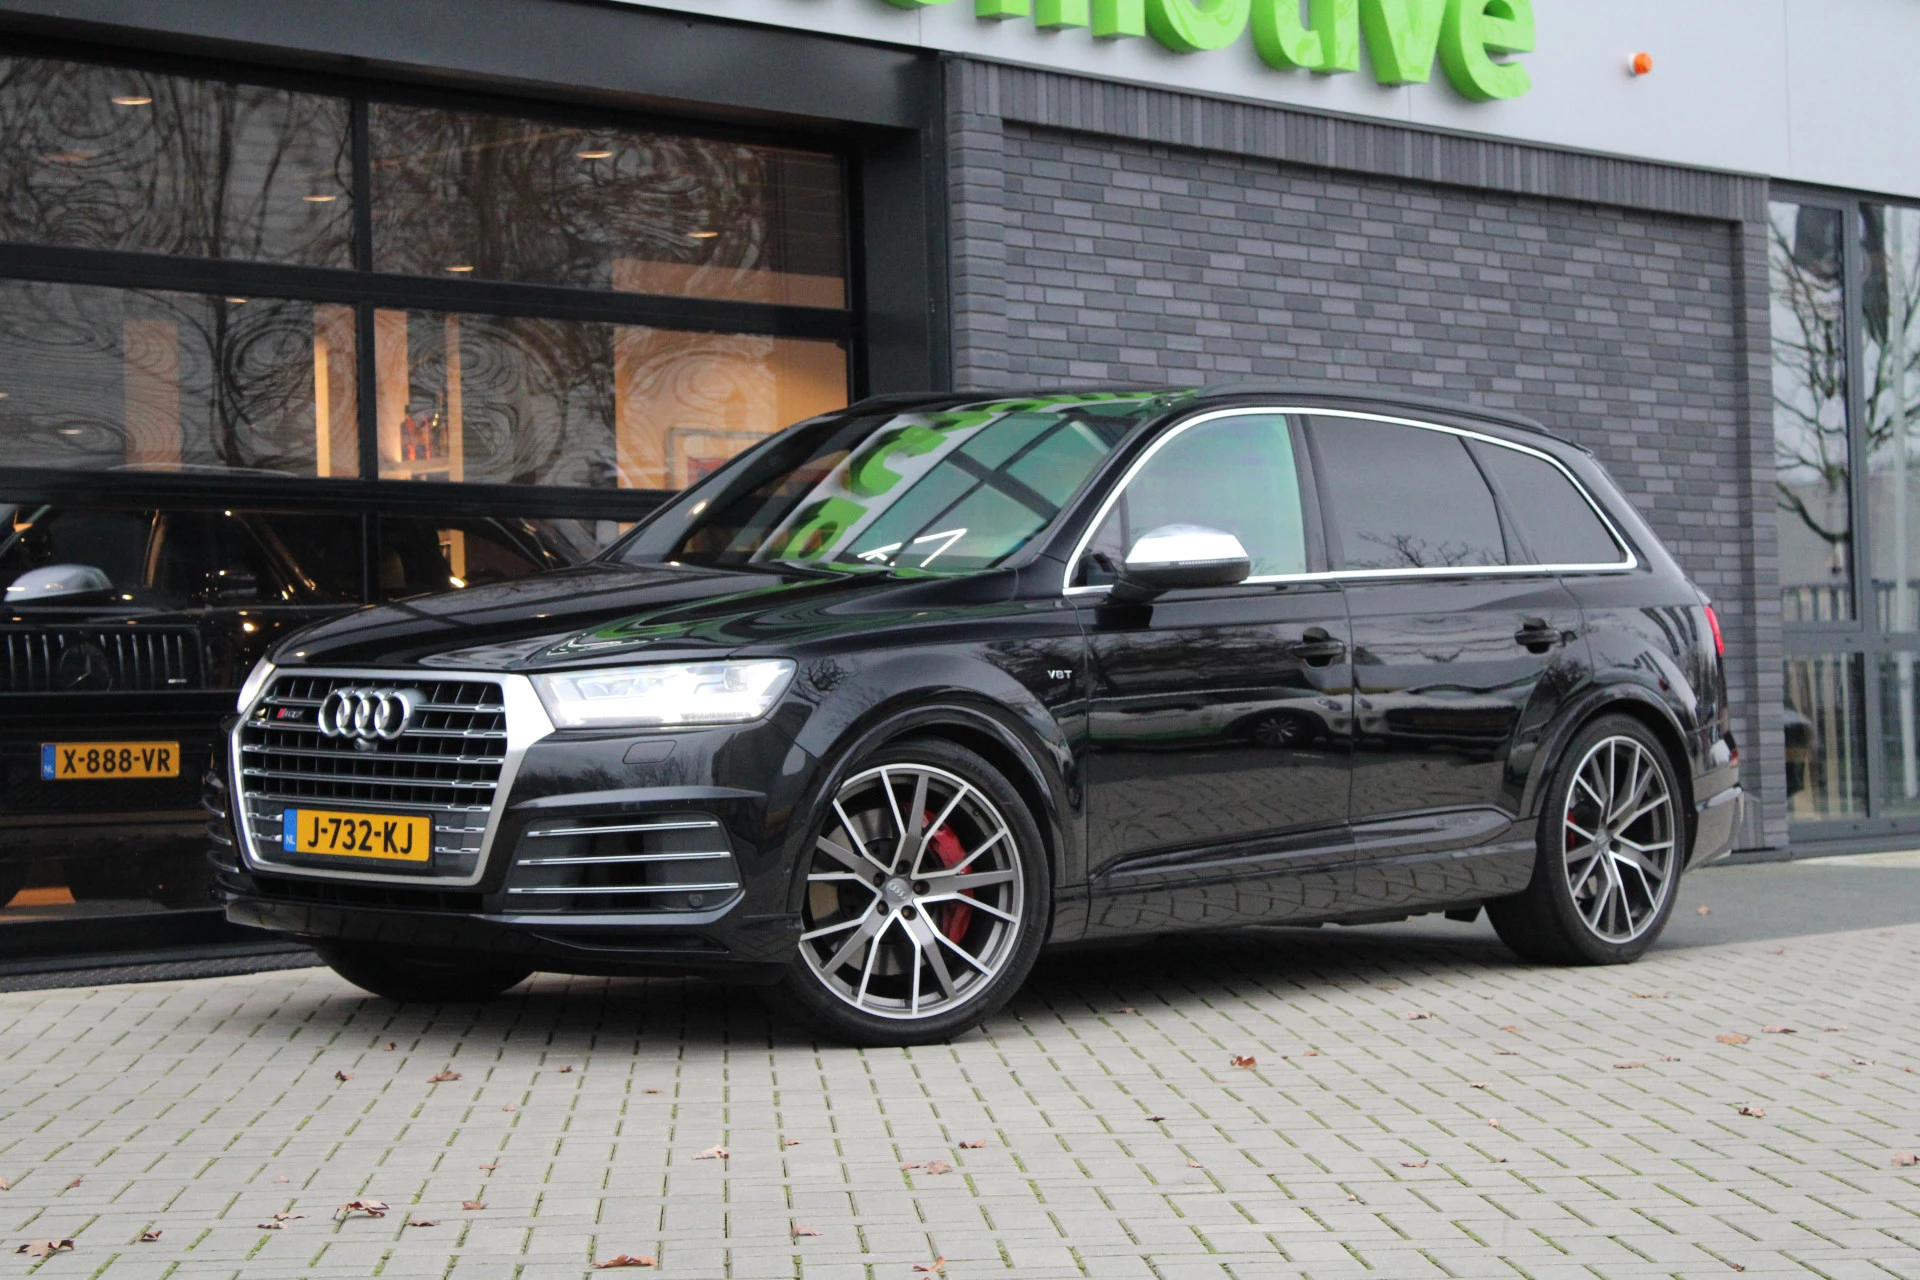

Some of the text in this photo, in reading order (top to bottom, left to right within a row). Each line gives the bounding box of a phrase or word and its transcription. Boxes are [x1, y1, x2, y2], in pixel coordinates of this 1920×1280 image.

[62, 748, 171, 775] X-888-VR
[285, 816, 413, 855] NL J-732-KJ
